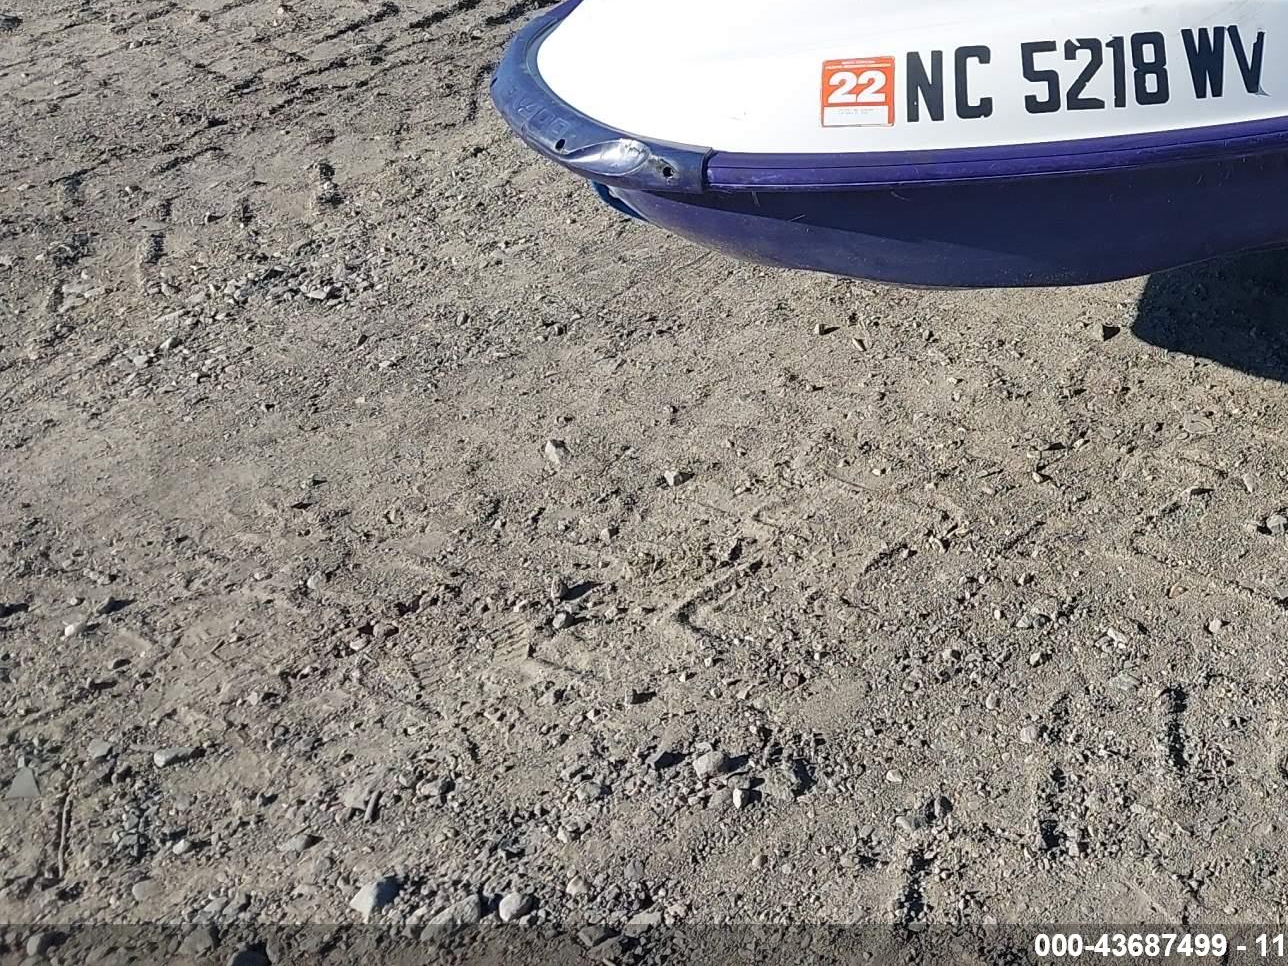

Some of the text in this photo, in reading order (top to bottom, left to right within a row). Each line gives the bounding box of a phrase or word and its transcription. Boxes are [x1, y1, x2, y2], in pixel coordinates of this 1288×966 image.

[827, 70, 887, 104] 22
[907, 25, 1269, 123] NC 5218 WV
